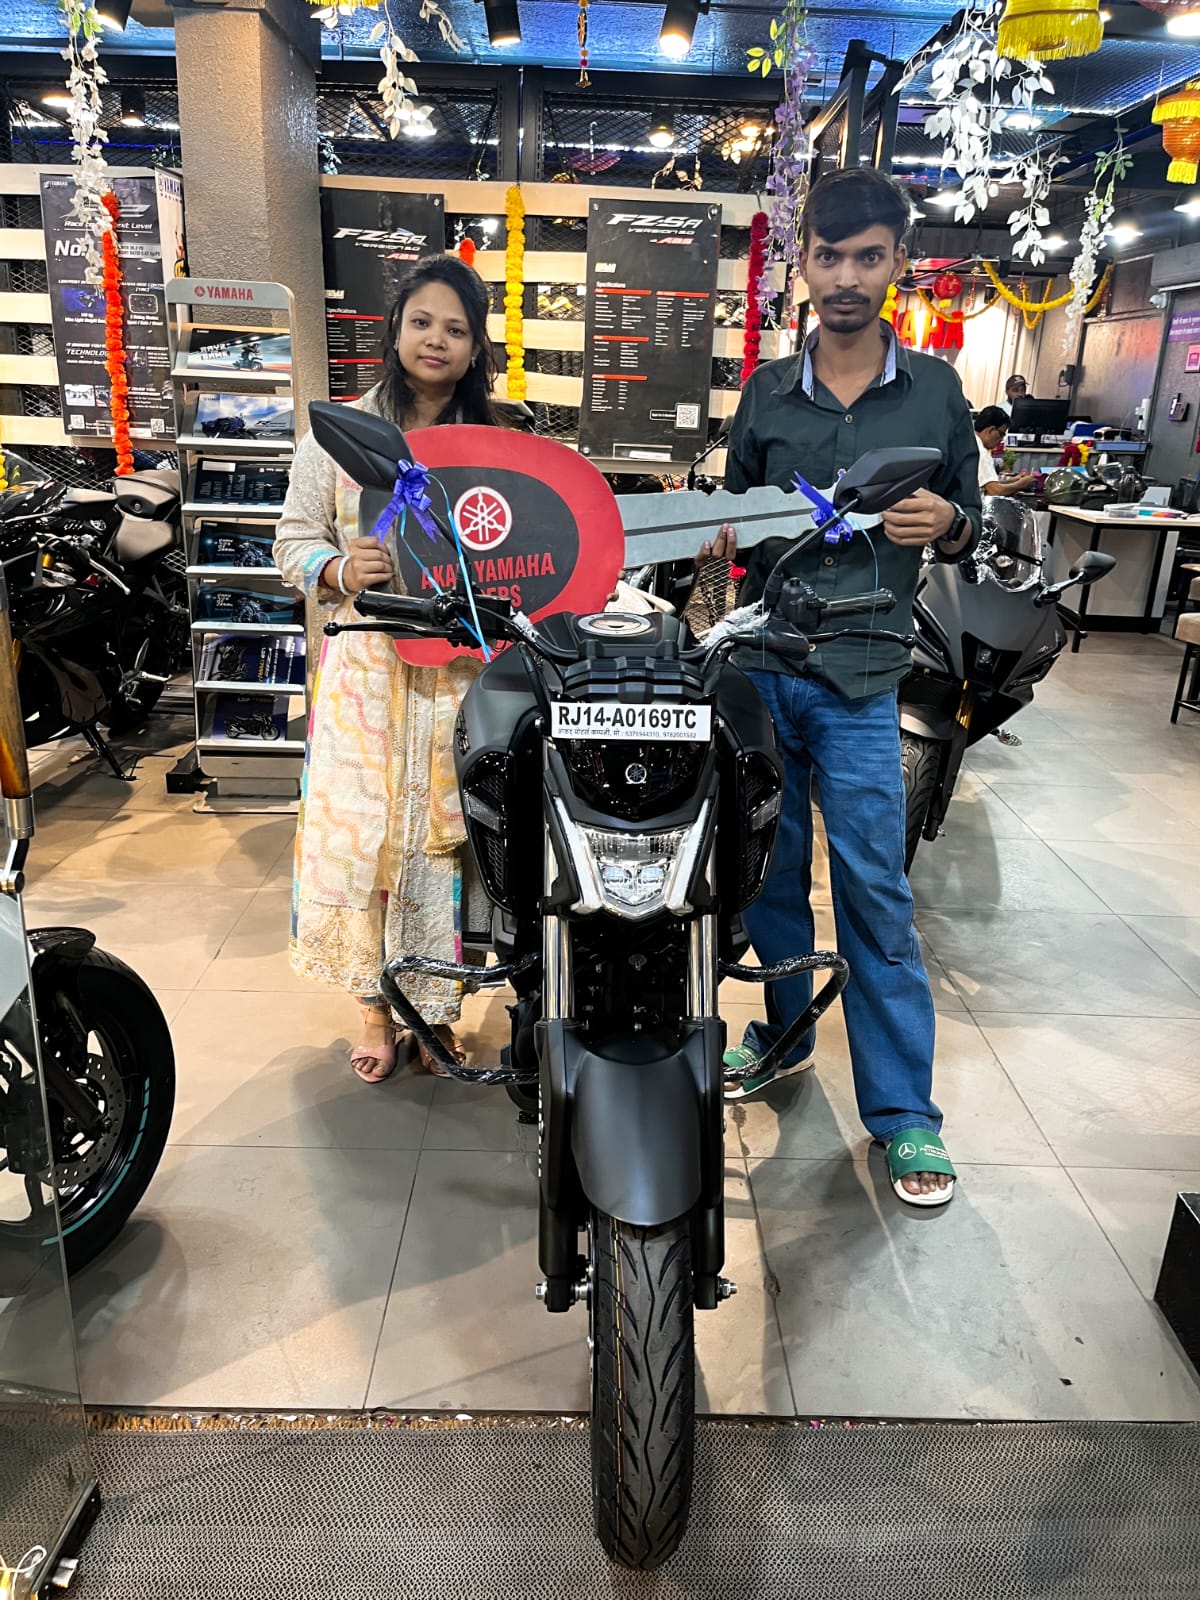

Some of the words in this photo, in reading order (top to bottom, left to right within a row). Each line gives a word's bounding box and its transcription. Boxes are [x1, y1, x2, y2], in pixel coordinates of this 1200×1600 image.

[207, 286, 253, 300] YAMAHA
[421, 563, 460, 590] AKA
[473, 552, 556, 583] YAMAHA
[558, 705, 697, 730] RJ14-A0169TC
